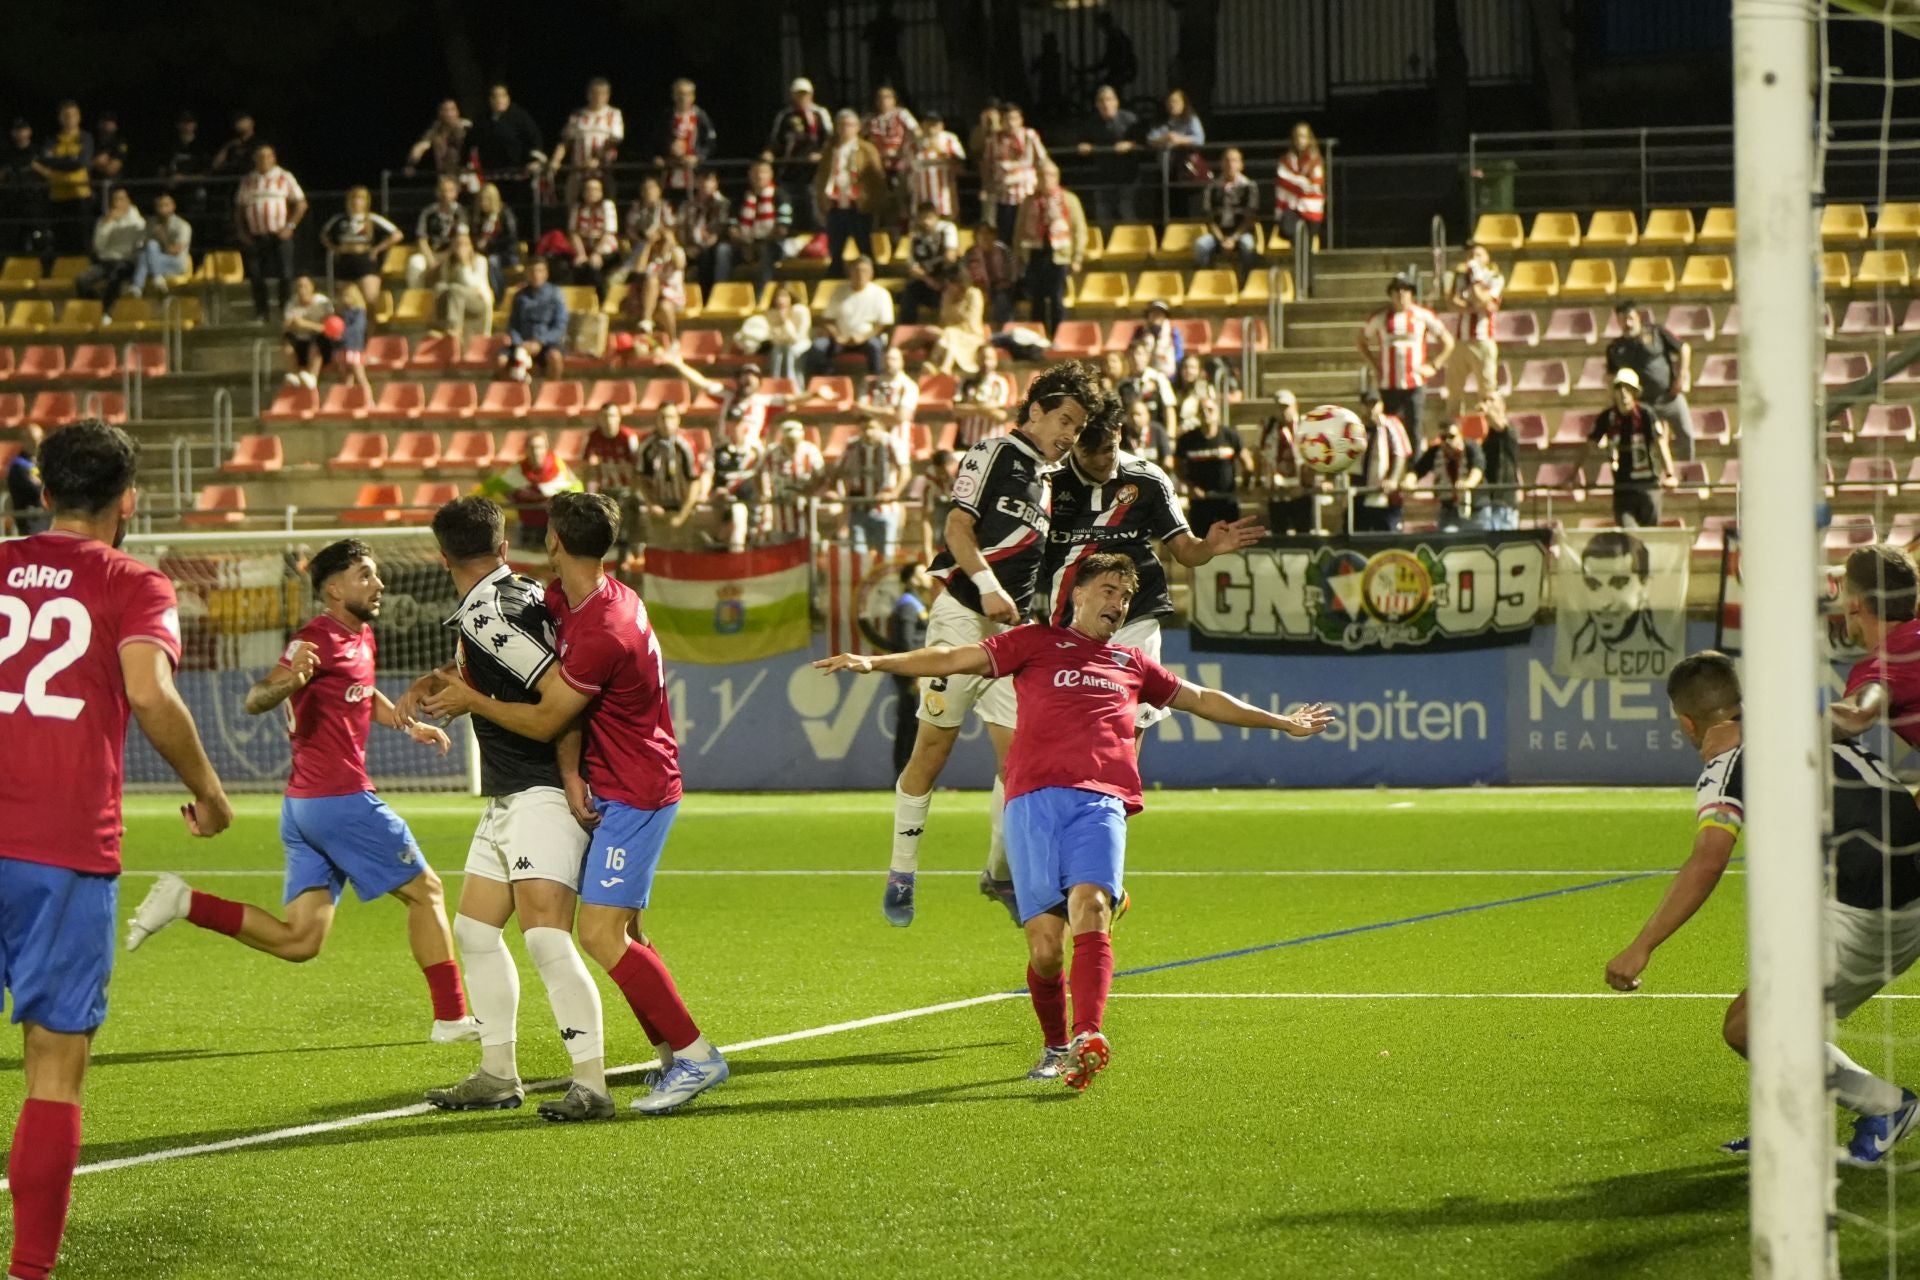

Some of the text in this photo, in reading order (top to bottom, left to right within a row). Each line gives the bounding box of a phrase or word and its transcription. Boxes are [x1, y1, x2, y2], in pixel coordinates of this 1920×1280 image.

[7, 564, 73, 590] CARO
[1193, 544, 1545, 636] GN 09
[1529, 659, 1682, 721] ME
[1529, 731, 1618, 750] REAL
[605, 846, 626, 871] 16
